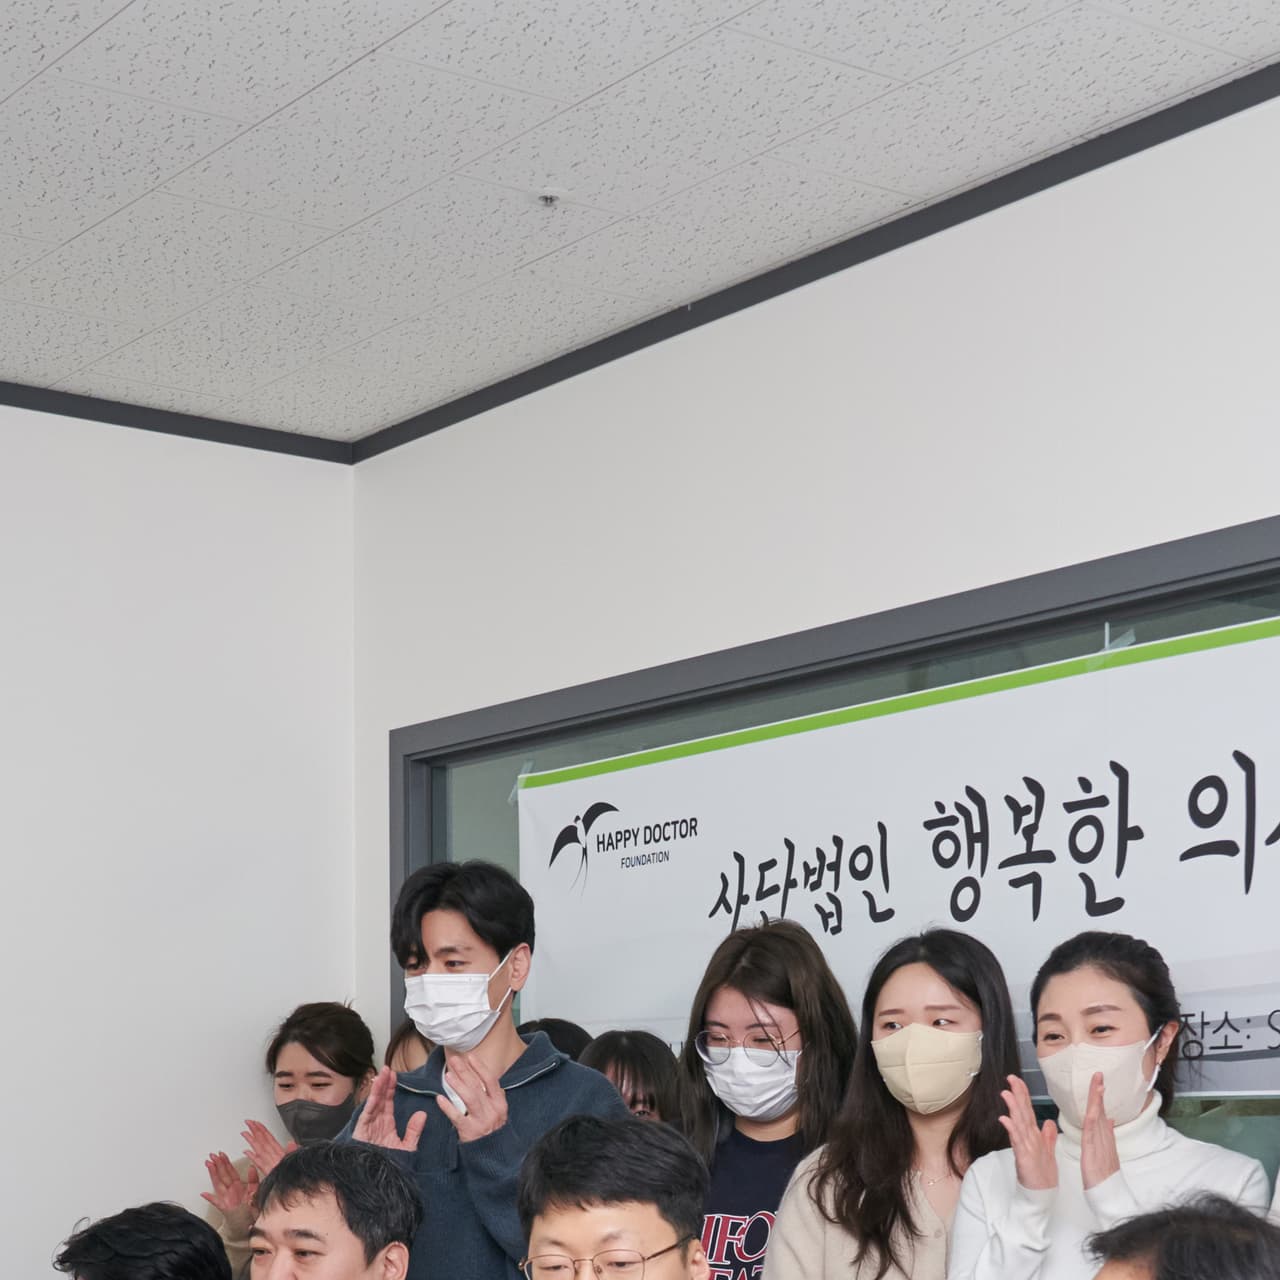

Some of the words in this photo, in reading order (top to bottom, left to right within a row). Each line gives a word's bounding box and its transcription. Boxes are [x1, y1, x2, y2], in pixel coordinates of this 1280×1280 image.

[596, 827, 640, 853] HAPPY
[643, 817, 698, 846] DOCTOR
[620, 850, 670, 869] FOUNDATION
[708, 821, 895, 936] 사단법인
[923, 760, 1145, 922] 행복한
[1179, 1010, 1251, 1060] 장소:
[701, 1210, 777, 1265] IFO
